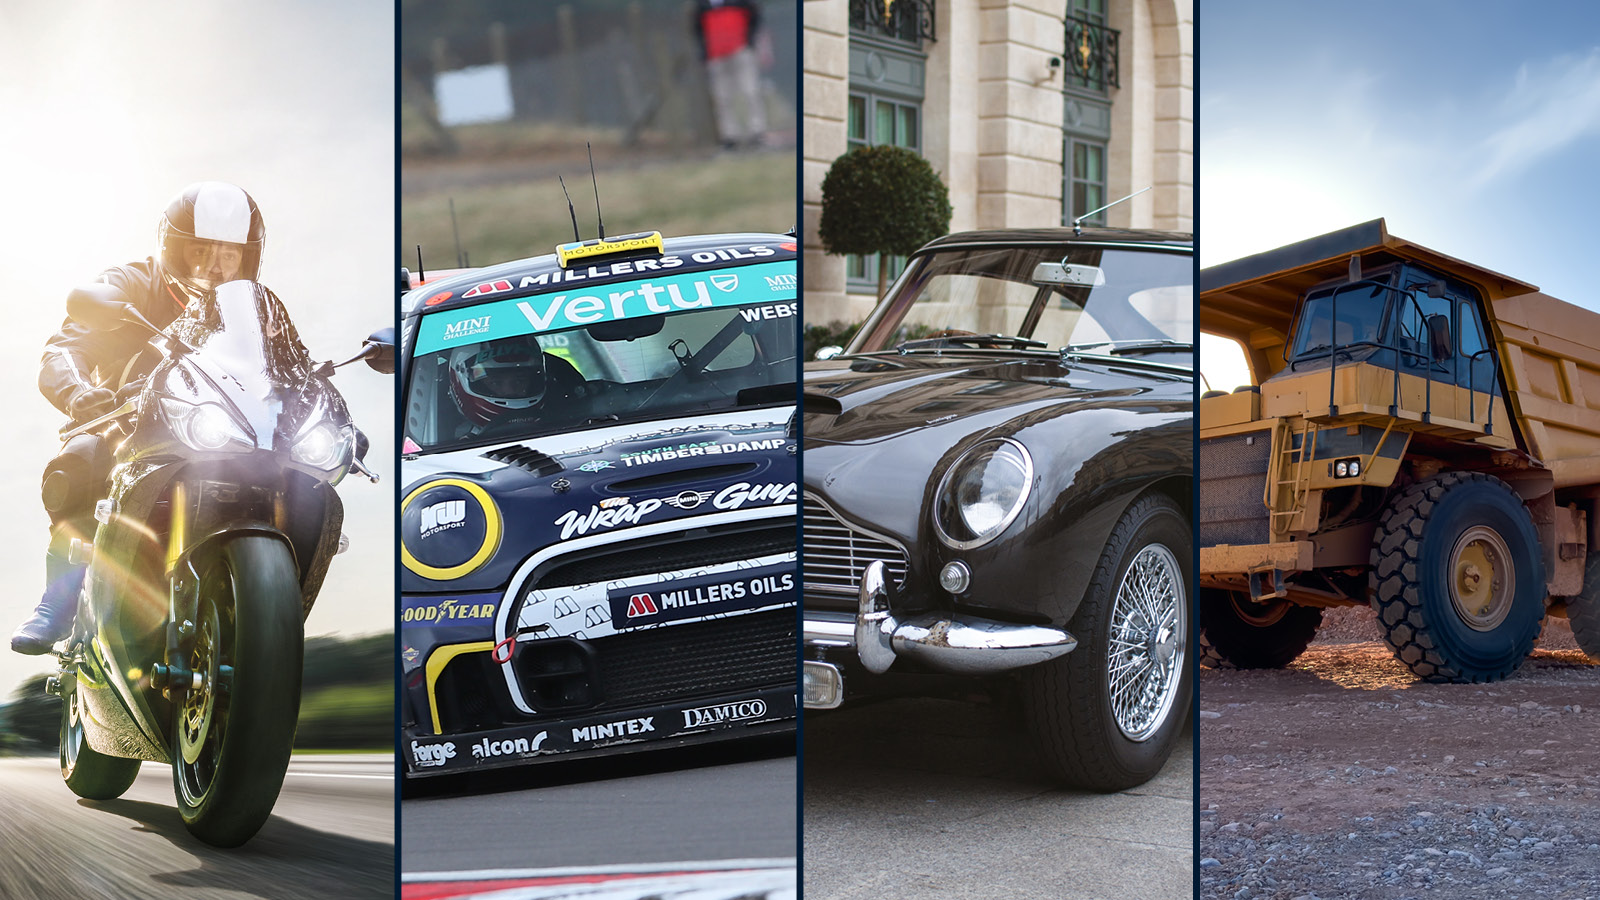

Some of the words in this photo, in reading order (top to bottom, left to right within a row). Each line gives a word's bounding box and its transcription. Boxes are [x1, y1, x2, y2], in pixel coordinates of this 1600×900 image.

[564, 238, 657, 256] MOTORSPORT
[519, 256, 684, 288] MILLERS
[691, 245, 775, 263] OILS
[443, 327, 490, 340] CHALLENGE
[444, 316, 492, 335] MINI
[620, 446, 673, 458] SOUTH
[679, 441, 719, 450] EAST
[620, 447, 705, 467] TIMBER
[721, 439, 786, 454] DAMP
[421, 522, 466, 540] MOTORSPORT
[660, 581, 746, 610] MILLERS
[750, 574, 794, 596] OILS
[681, 701, 764, 729] DAMICO
[571, 717, 655, 743] MINTEX
[411, 740, 457, 766] forge
[471, 737, 529, 758] alcon
